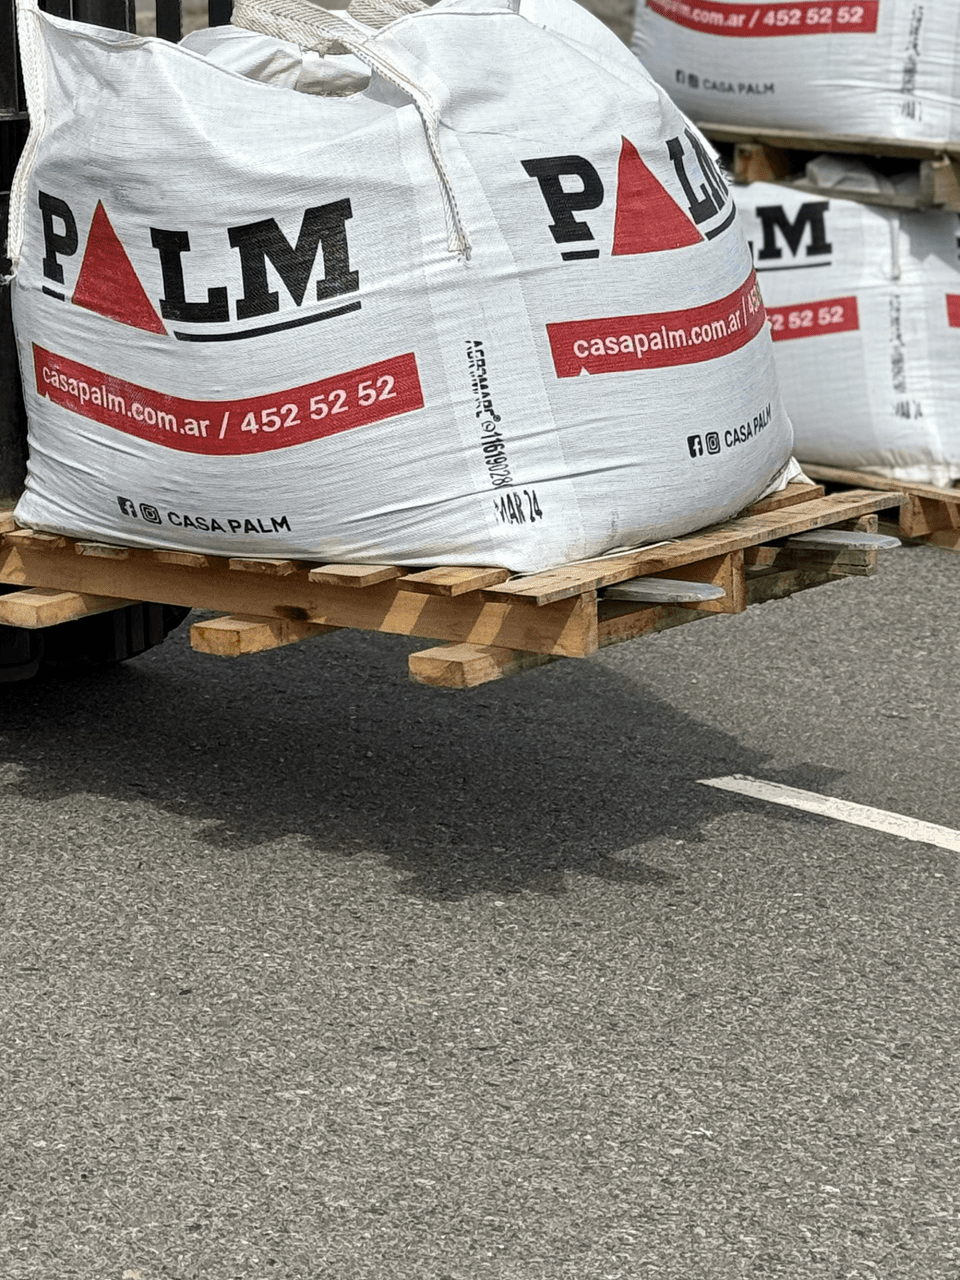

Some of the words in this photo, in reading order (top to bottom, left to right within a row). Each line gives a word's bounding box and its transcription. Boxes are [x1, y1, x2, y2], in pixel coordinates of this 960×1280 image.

[763, 7, 801, 27] 452
[806, 7, 832, 26] 52
[837, 6, 864, 24] 52
[703, 78, 735, 94] CASA
[738, 81, 775, 95] PALM
[38, 190, 360, 336] PALM
[573, 309, 742, 359] casapalm.com.ar
[788, 310, 814, 329] 52
[818, 306, 844, 325] 52
[42, 366, 210, 439] casapalm.com.ar
[240, 405, 299, 435] 452
[309, 389, 347, 420] 52
[357, 375, 397, 407] 52
[724, 422, 751, 448] CASA
[753, 402, 772, 437] PALM
[167, 511, 227, 534] CASA
[229, 515, 292, 535] PALM
